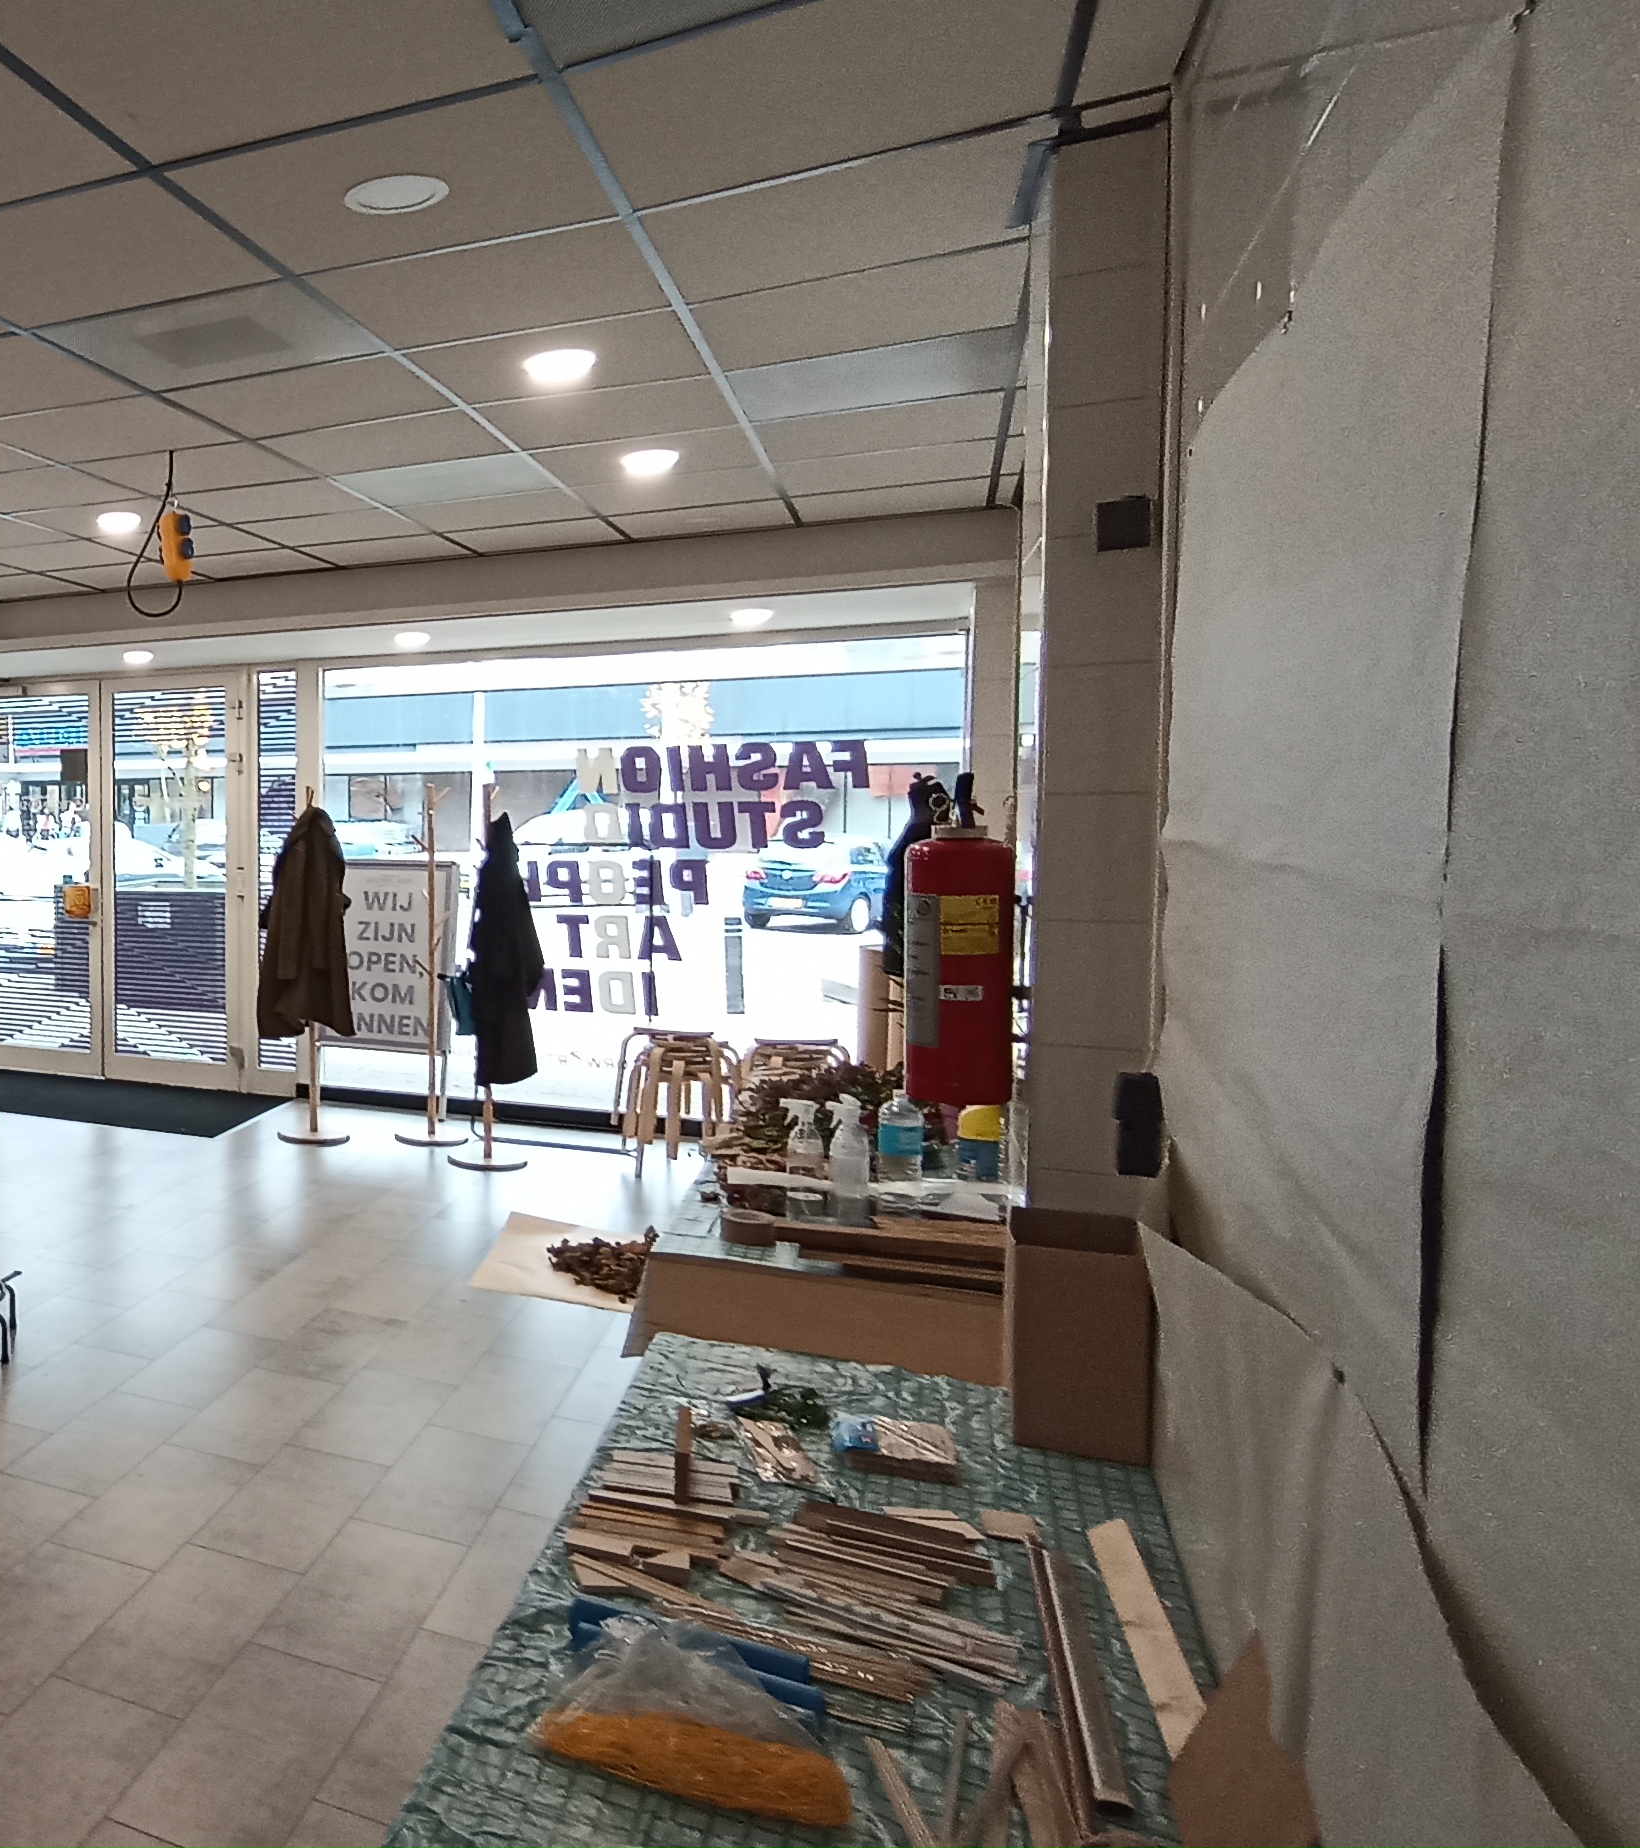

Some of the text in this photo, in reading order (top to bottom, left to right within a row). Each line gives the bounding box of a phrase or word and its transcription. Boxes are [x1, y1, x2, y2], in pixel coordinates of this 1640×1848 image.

[363, 890, 413, 912] WIJ
[357, 921, 416, 943] ZIJN
[351, 981, 415, 1005] KOM
[356, 1012, 431, 1037] NNEN
